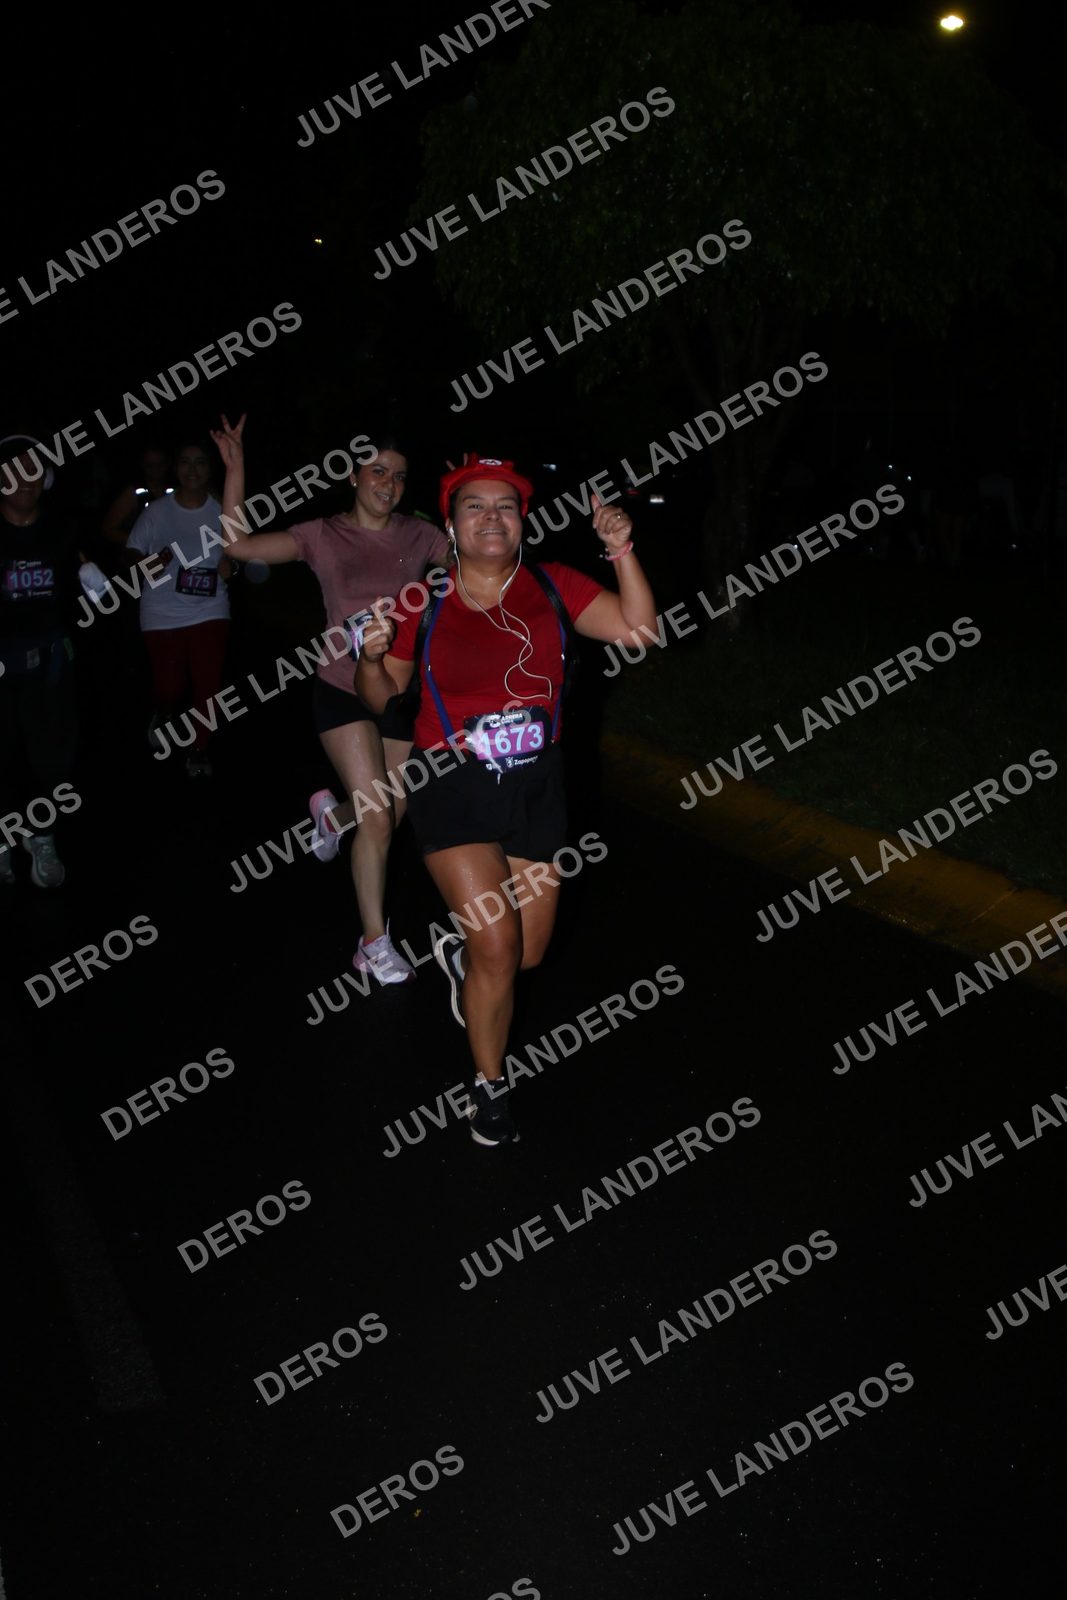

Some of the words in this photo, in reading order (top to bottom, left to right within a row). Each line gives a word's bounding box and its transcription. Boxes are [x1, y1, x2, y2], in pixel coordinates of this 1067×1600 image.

[9, 568, 54, 589] 1052
[186, 575, 210, 588] 175
[480, 724, 543, 757] 1673
